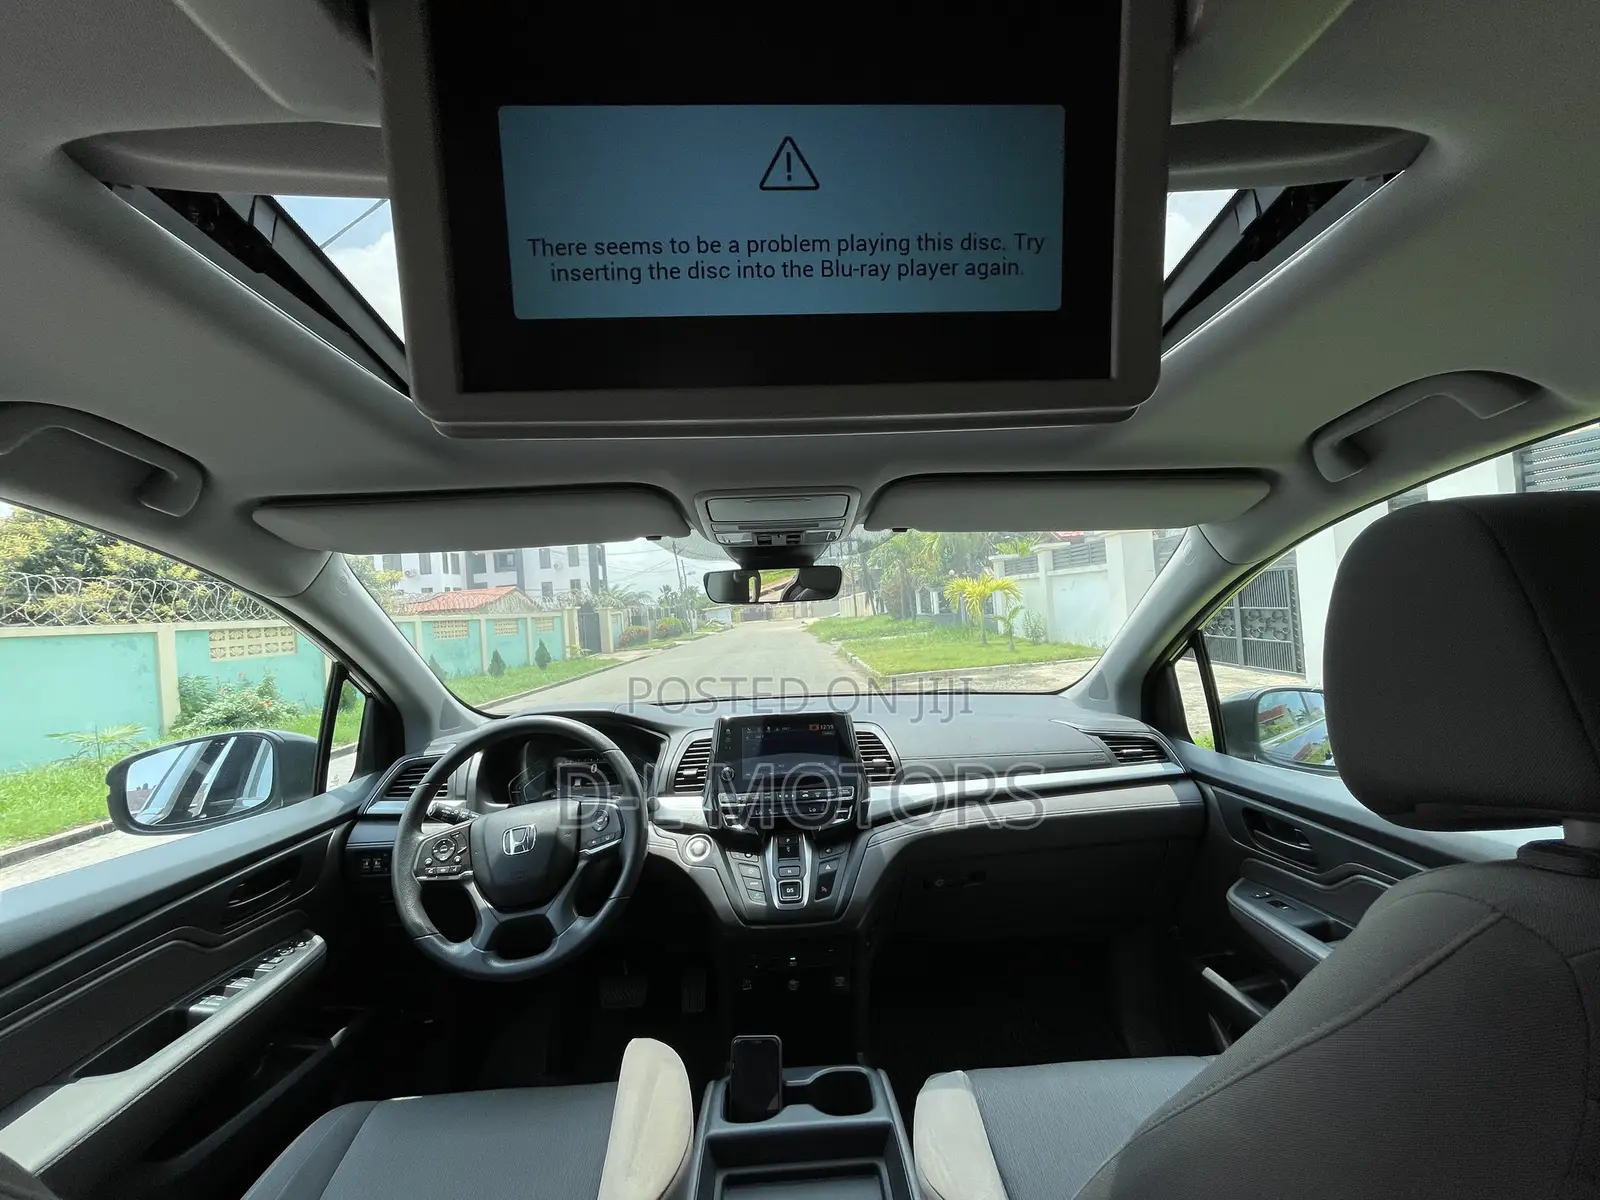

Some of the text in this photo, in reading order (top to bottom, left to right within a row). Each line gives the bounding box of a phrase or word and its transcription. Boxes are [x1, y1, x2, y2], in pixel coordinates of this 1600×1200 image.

[526, 232, 1045, 257] There seems to be a problem playing this disc. Try
[551, 256, 1024, 285] inserting the disc into the Blu-ray player again.
